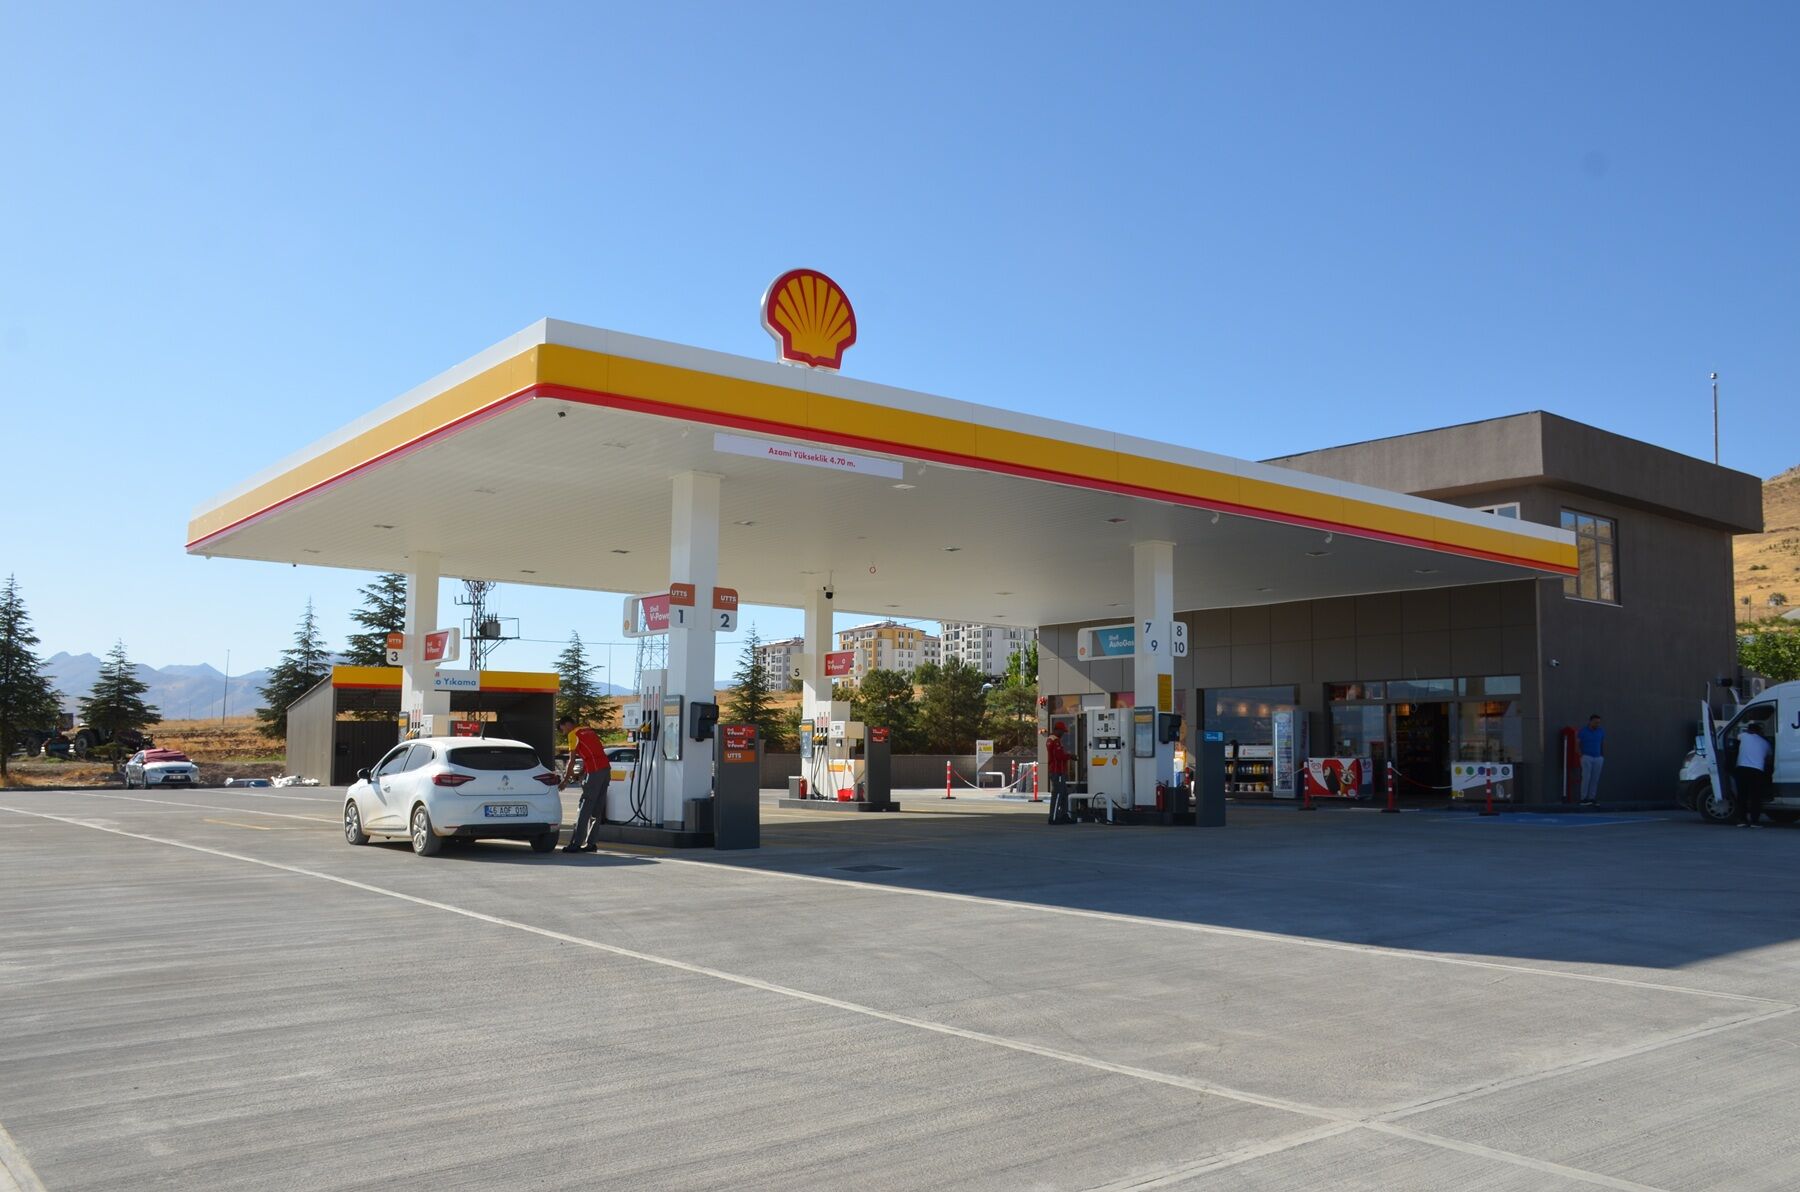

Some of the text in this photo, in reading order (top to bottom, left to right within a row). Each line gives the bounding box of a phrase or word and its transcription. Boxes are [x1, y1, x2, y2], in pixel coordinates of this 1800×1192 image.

[768, 447, 792, 457] Azami
[793, 450, 828, 463] Yükseklik
[829, 457, 846, 466] 4.70
[671, 590, 688, 598] UTTS
[720, 595, 737, 603] UTTS
[678, 609, 684, 624] 1
[720, 613, 730, 628] 2
[1144, 622, 1152, 634] 7
[1176, 625, 1183, 637] 8
[1151, 640, 1158, 652] 9
[1174, 642, 1185, 654] 10
[390, 651, 399, 662] 3
[794, 668, 800, 677] 5
